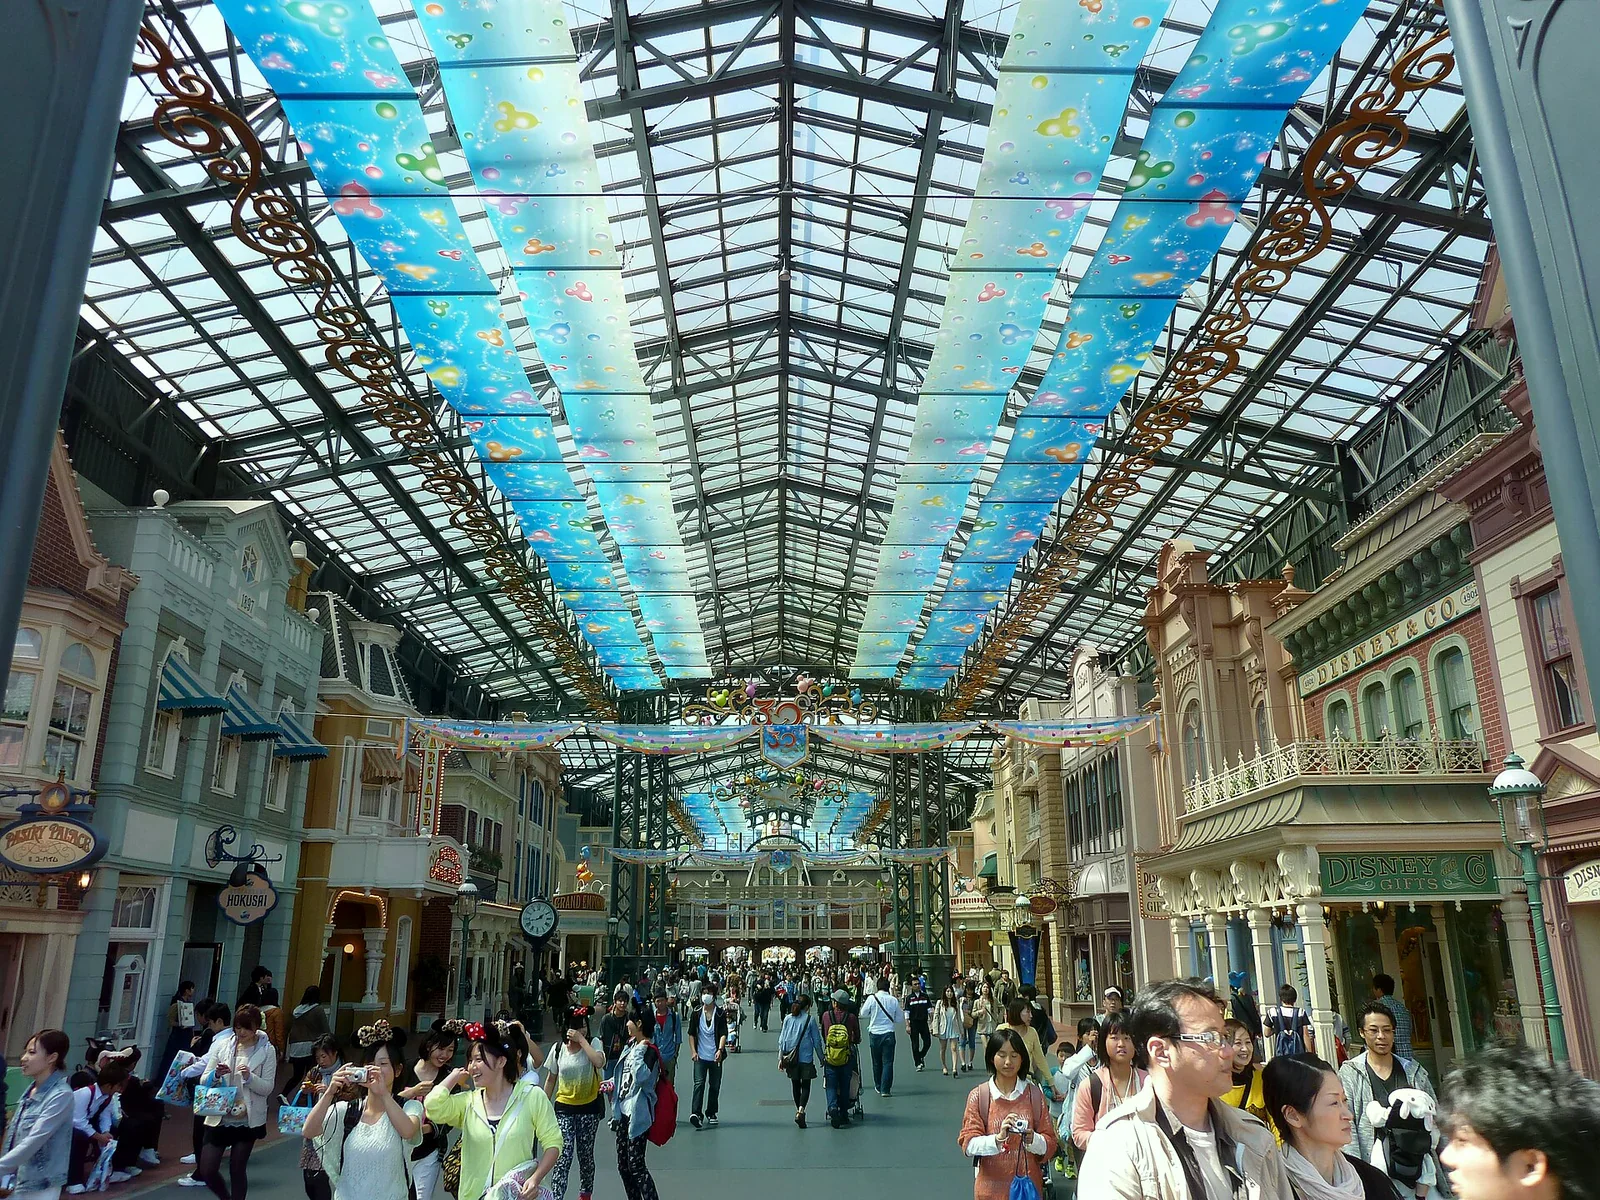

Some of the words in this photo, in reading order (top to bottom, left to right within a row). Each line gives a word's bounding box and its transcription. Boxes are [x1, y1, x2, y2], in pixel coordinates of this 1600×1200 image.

[1317, 626, 1400, 686] DISNEY
[1406, 618, 1419, 639] &
[1424, 596, 1459, 629] CO.
[423, 736, 437, 826] ARCADE
[5, 824, 48, 850] PASTRY
[49, 823, 92, 853] PALACE
[1326, 856, 1437, 888] DISNEY
[1380, 878, 1438, 891] GIFTS
[226, 894, 267, 907] HOKUSAI
[554, 894, 581, 909] GRAND
